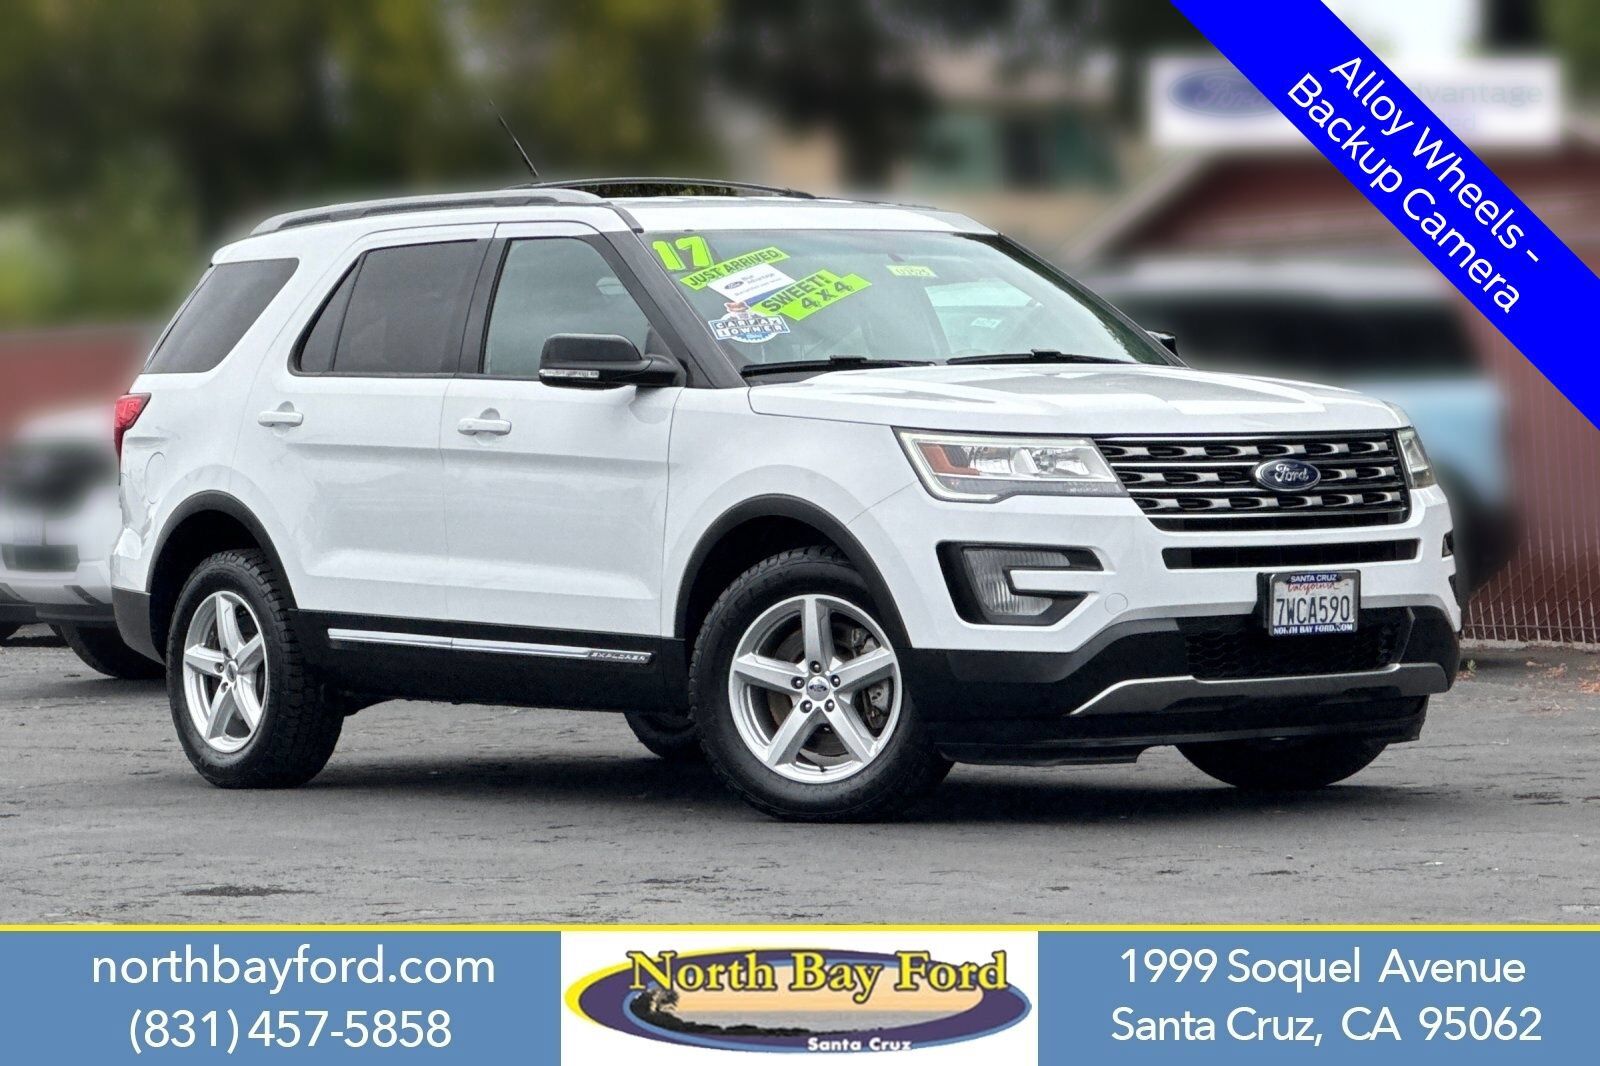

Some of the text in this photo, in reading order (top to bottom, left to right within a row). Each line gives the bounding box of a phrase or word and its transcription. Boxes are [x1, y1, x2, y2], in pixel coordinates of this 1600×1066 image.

[652, 236, 714, 271] 17
[688, 249, 779, 286] JUST ARRIVED
[762, 275, 831, 311] SWEET!
[1275, 464, 1309, 482] Ford
[1291, 574, 1337, 583] SANTA CRUZ
[1276, 596, 1349, 625] 7WCA590
[1299, 625, 1313, 633] BAY
